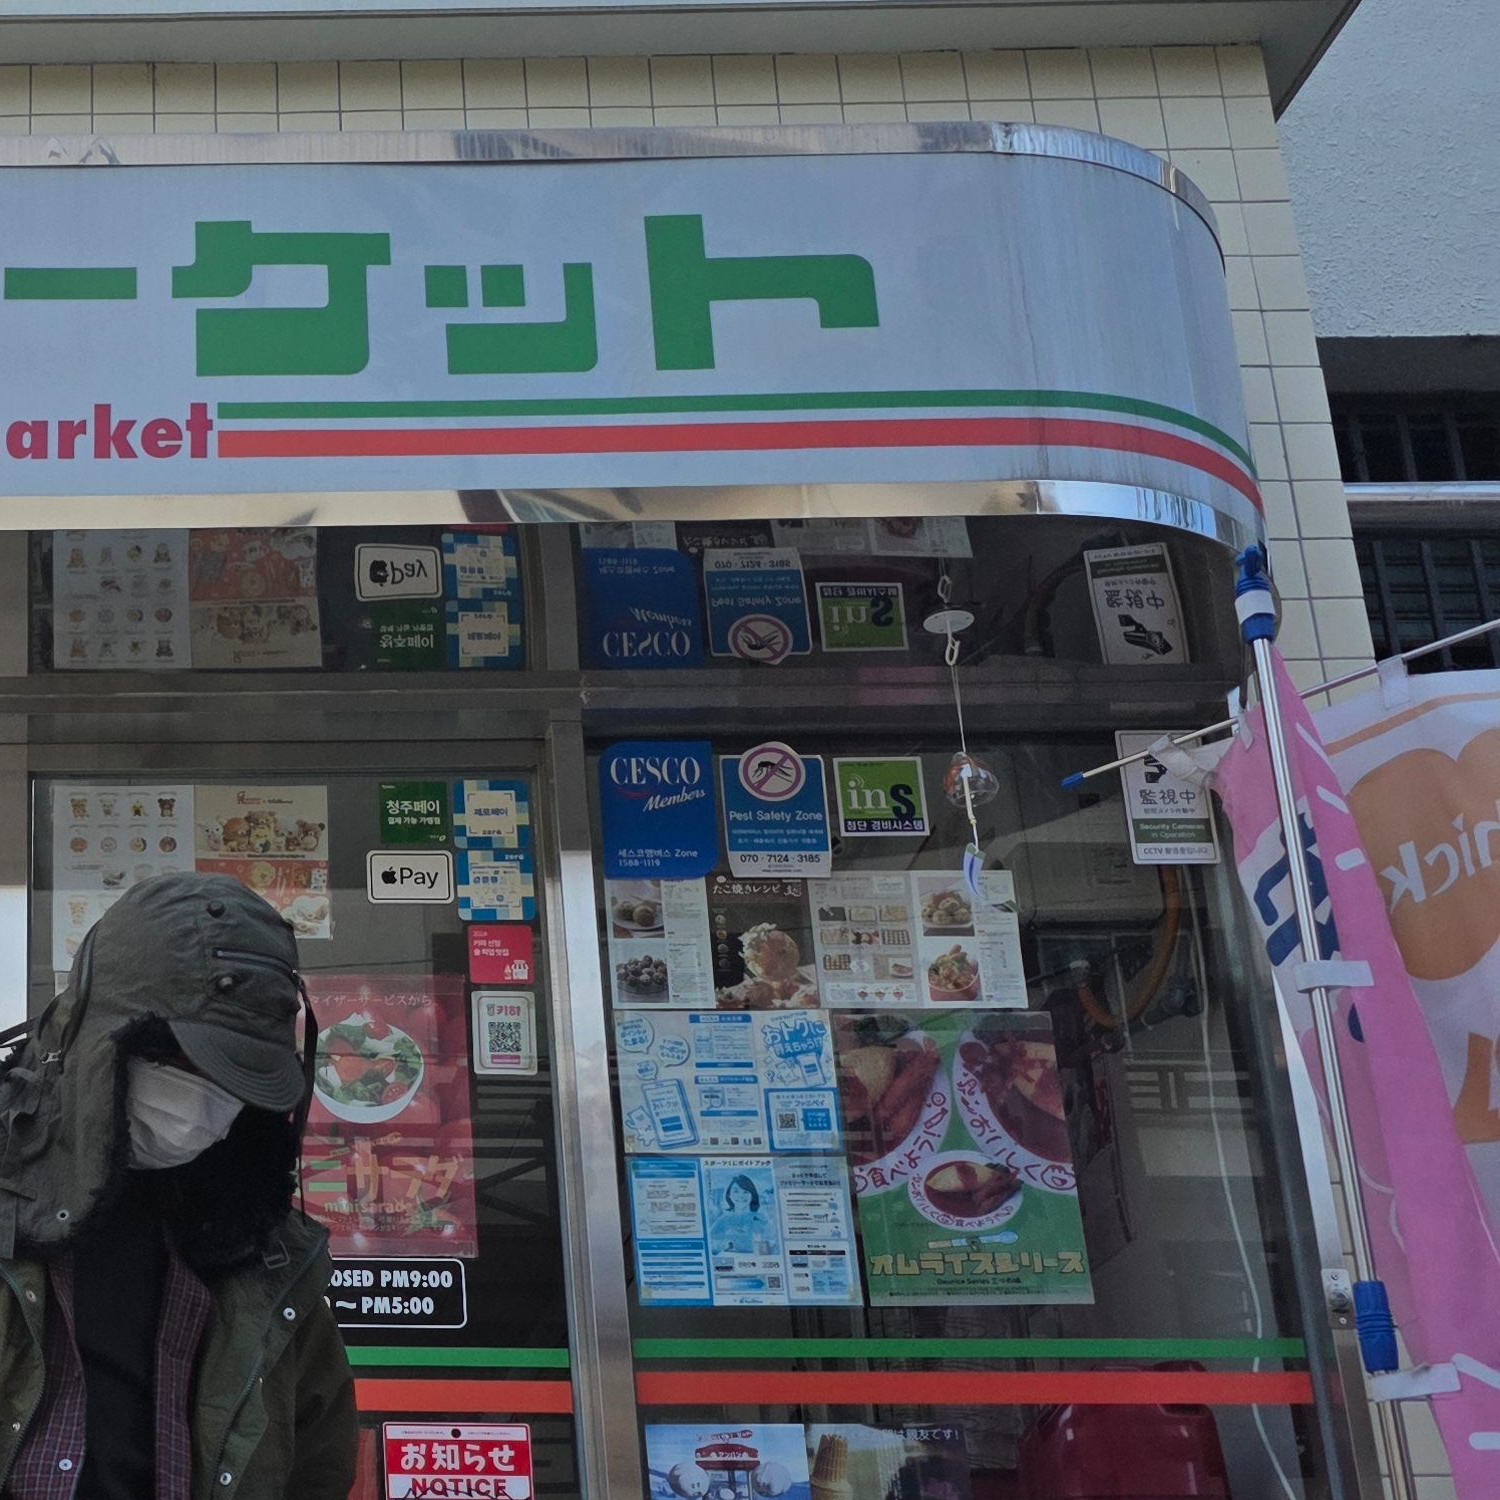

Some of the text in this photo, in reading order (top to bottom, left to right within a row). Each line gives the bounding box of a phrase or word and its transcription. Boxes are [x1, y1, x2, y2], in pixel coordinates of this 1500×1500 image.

[610, 757, 701, 786] CESCO
[643, 787, 706, 812] Members
[1139, 788, 1197, 806] 監視中
[386, 799, 441, 815] 청주페이
[729, 809, 824, 823] Pest Safety Zone
[674, 848, 699, 859] Zone
[739, 853, 821, 864] 070 7124 3185
[399, 869, 439, 889] Pay
[328, 1269, 453, 1289] OSED PM9:00
[361, 1296, 434, 1315] PM5:00
[400, 1442, 516, 1473] お知らせ
[411, 1477, 507, 1498] NOTICE
